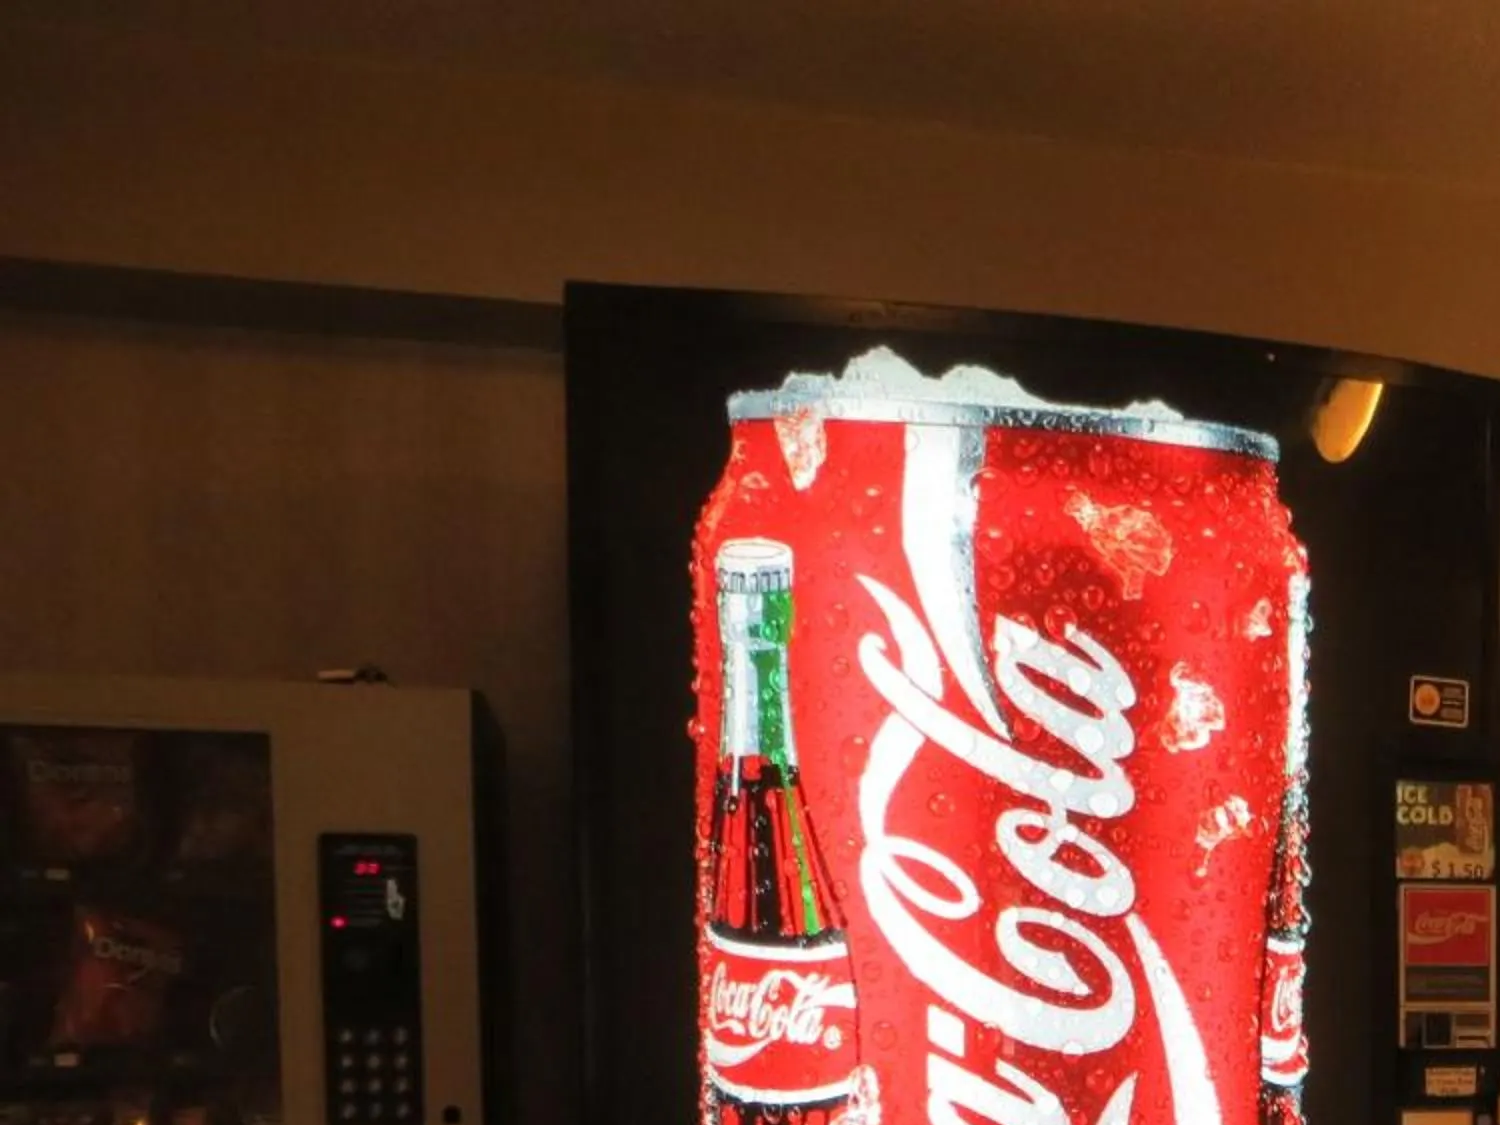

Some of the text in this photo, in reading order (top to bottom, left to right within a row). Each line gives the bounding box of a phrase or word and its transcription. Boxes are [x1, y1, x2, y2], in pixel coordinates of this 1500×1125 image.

[1397, 785, 1428, 804] ICE
[1397, 805, 1454, 825] COLD
[711, 961, 824, 1045] Coca-Cola
